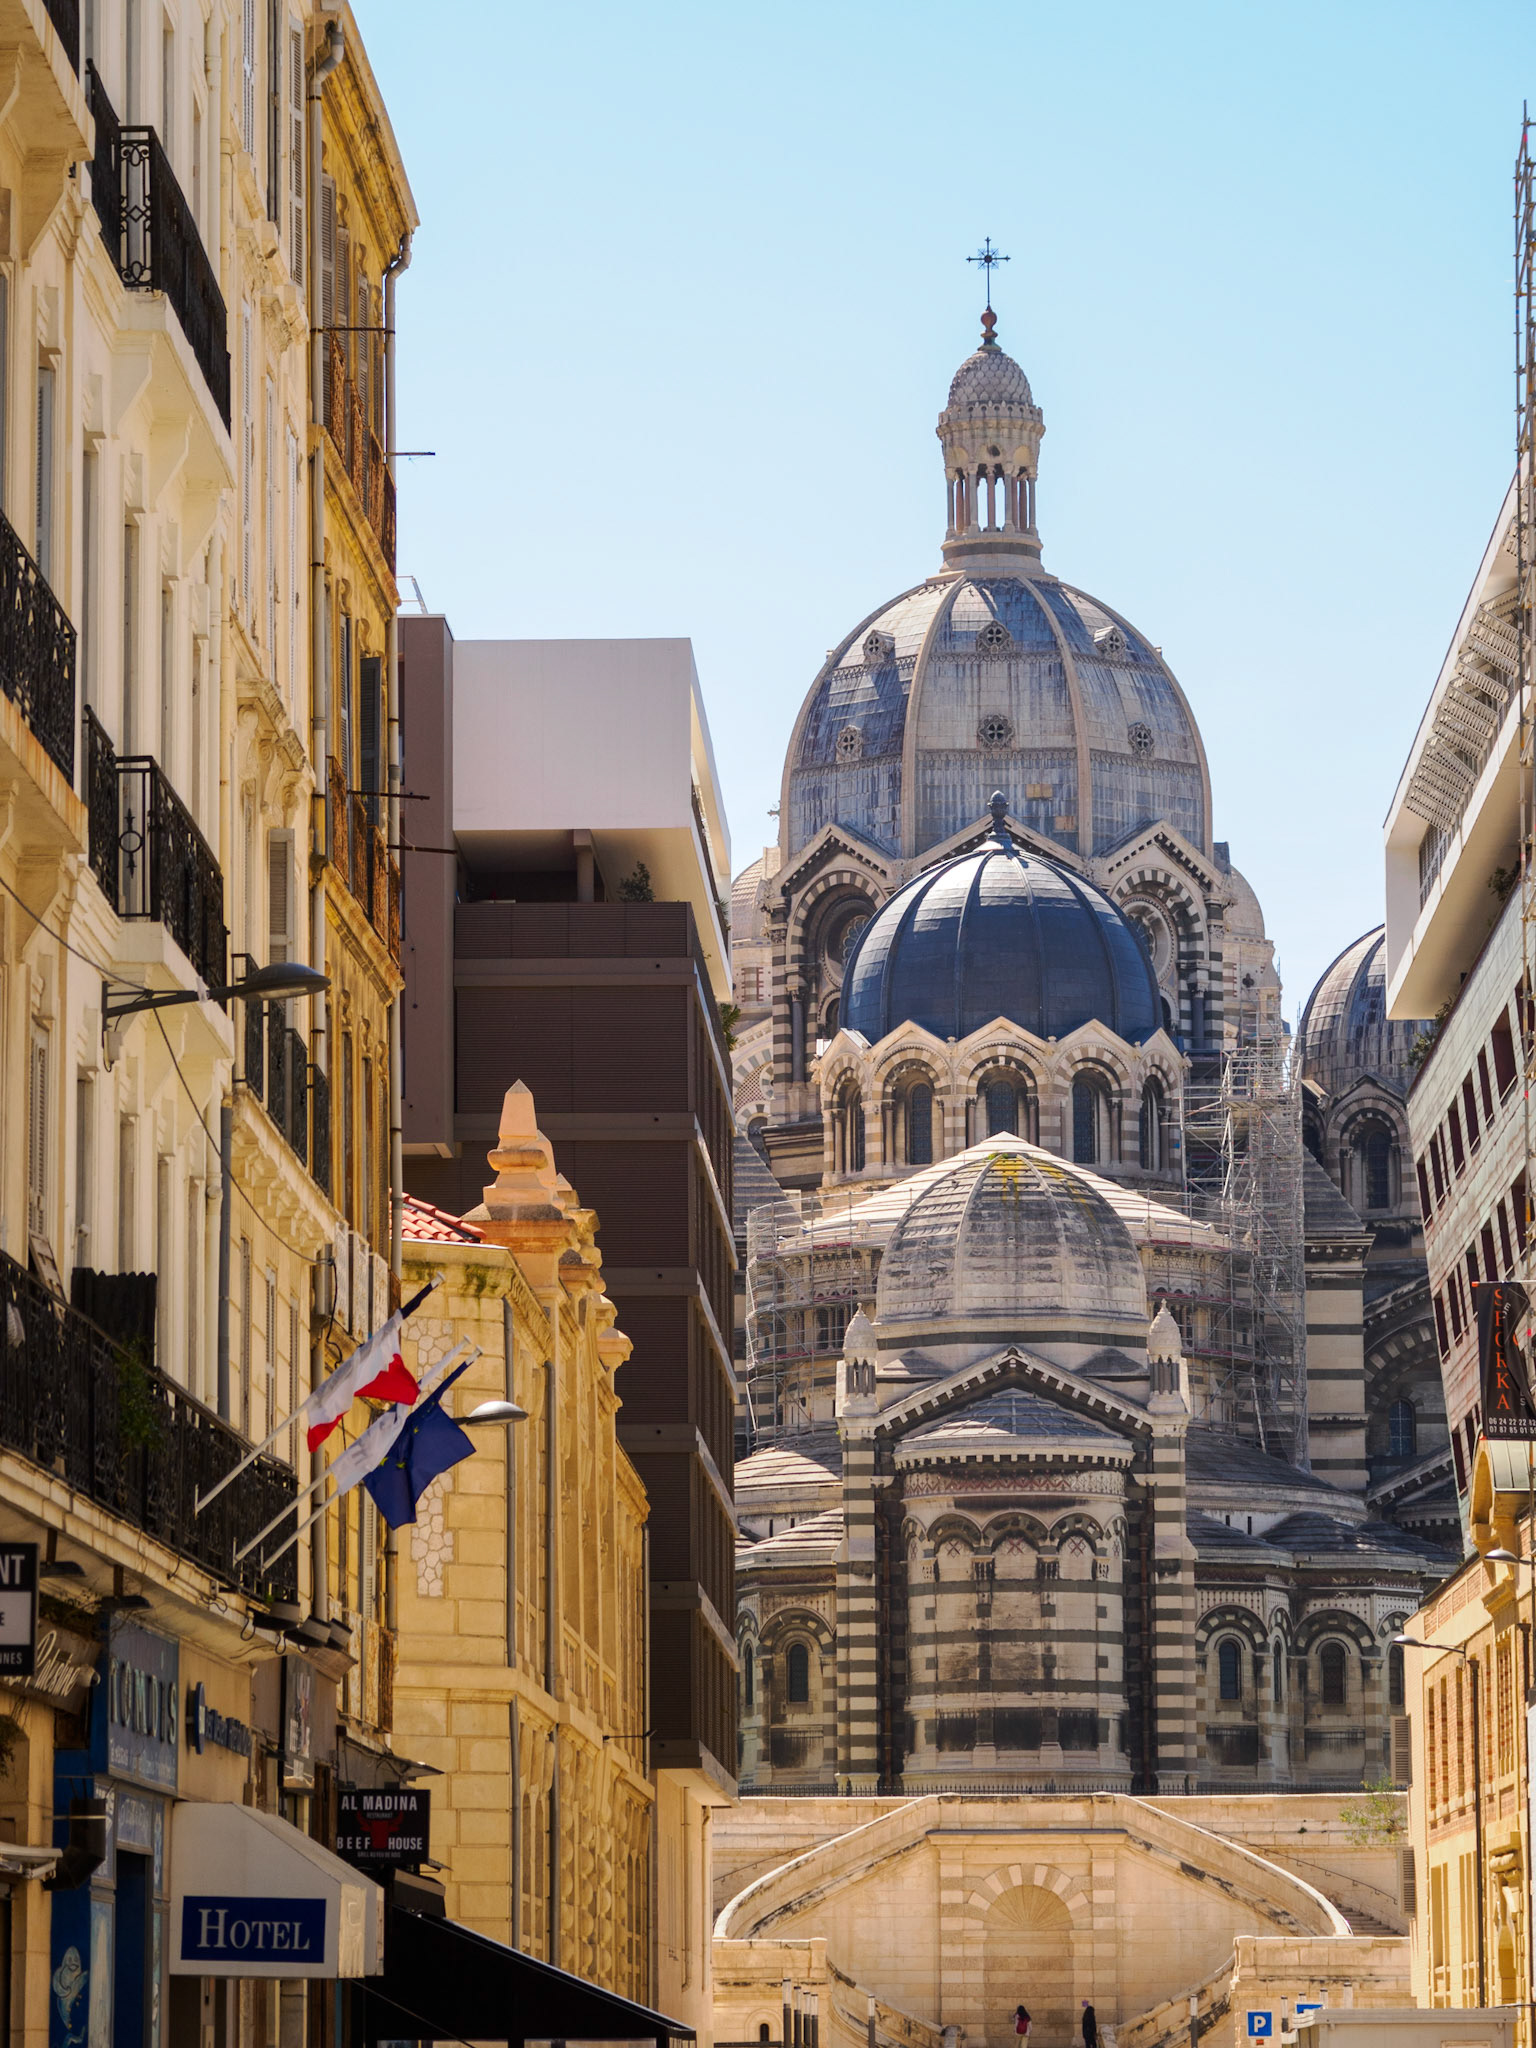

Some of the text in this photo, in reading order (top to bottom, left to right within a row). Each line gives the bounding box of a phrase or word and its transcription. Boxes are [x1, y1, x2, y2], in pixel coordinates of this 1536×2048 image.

[1488, 1417, 1497, 1425] 06
[1509, 1418, 1517, 1426] 22
[1519, 1418, 1527, 1426] 22
[341, 1795, 418, 1811] AL MADINA
[336, 1836, 423, 1850] BEEF HOUSE
[196, 1908, 310, 1950] HOTEL
[1253, 2015, 1267, 2033] P
